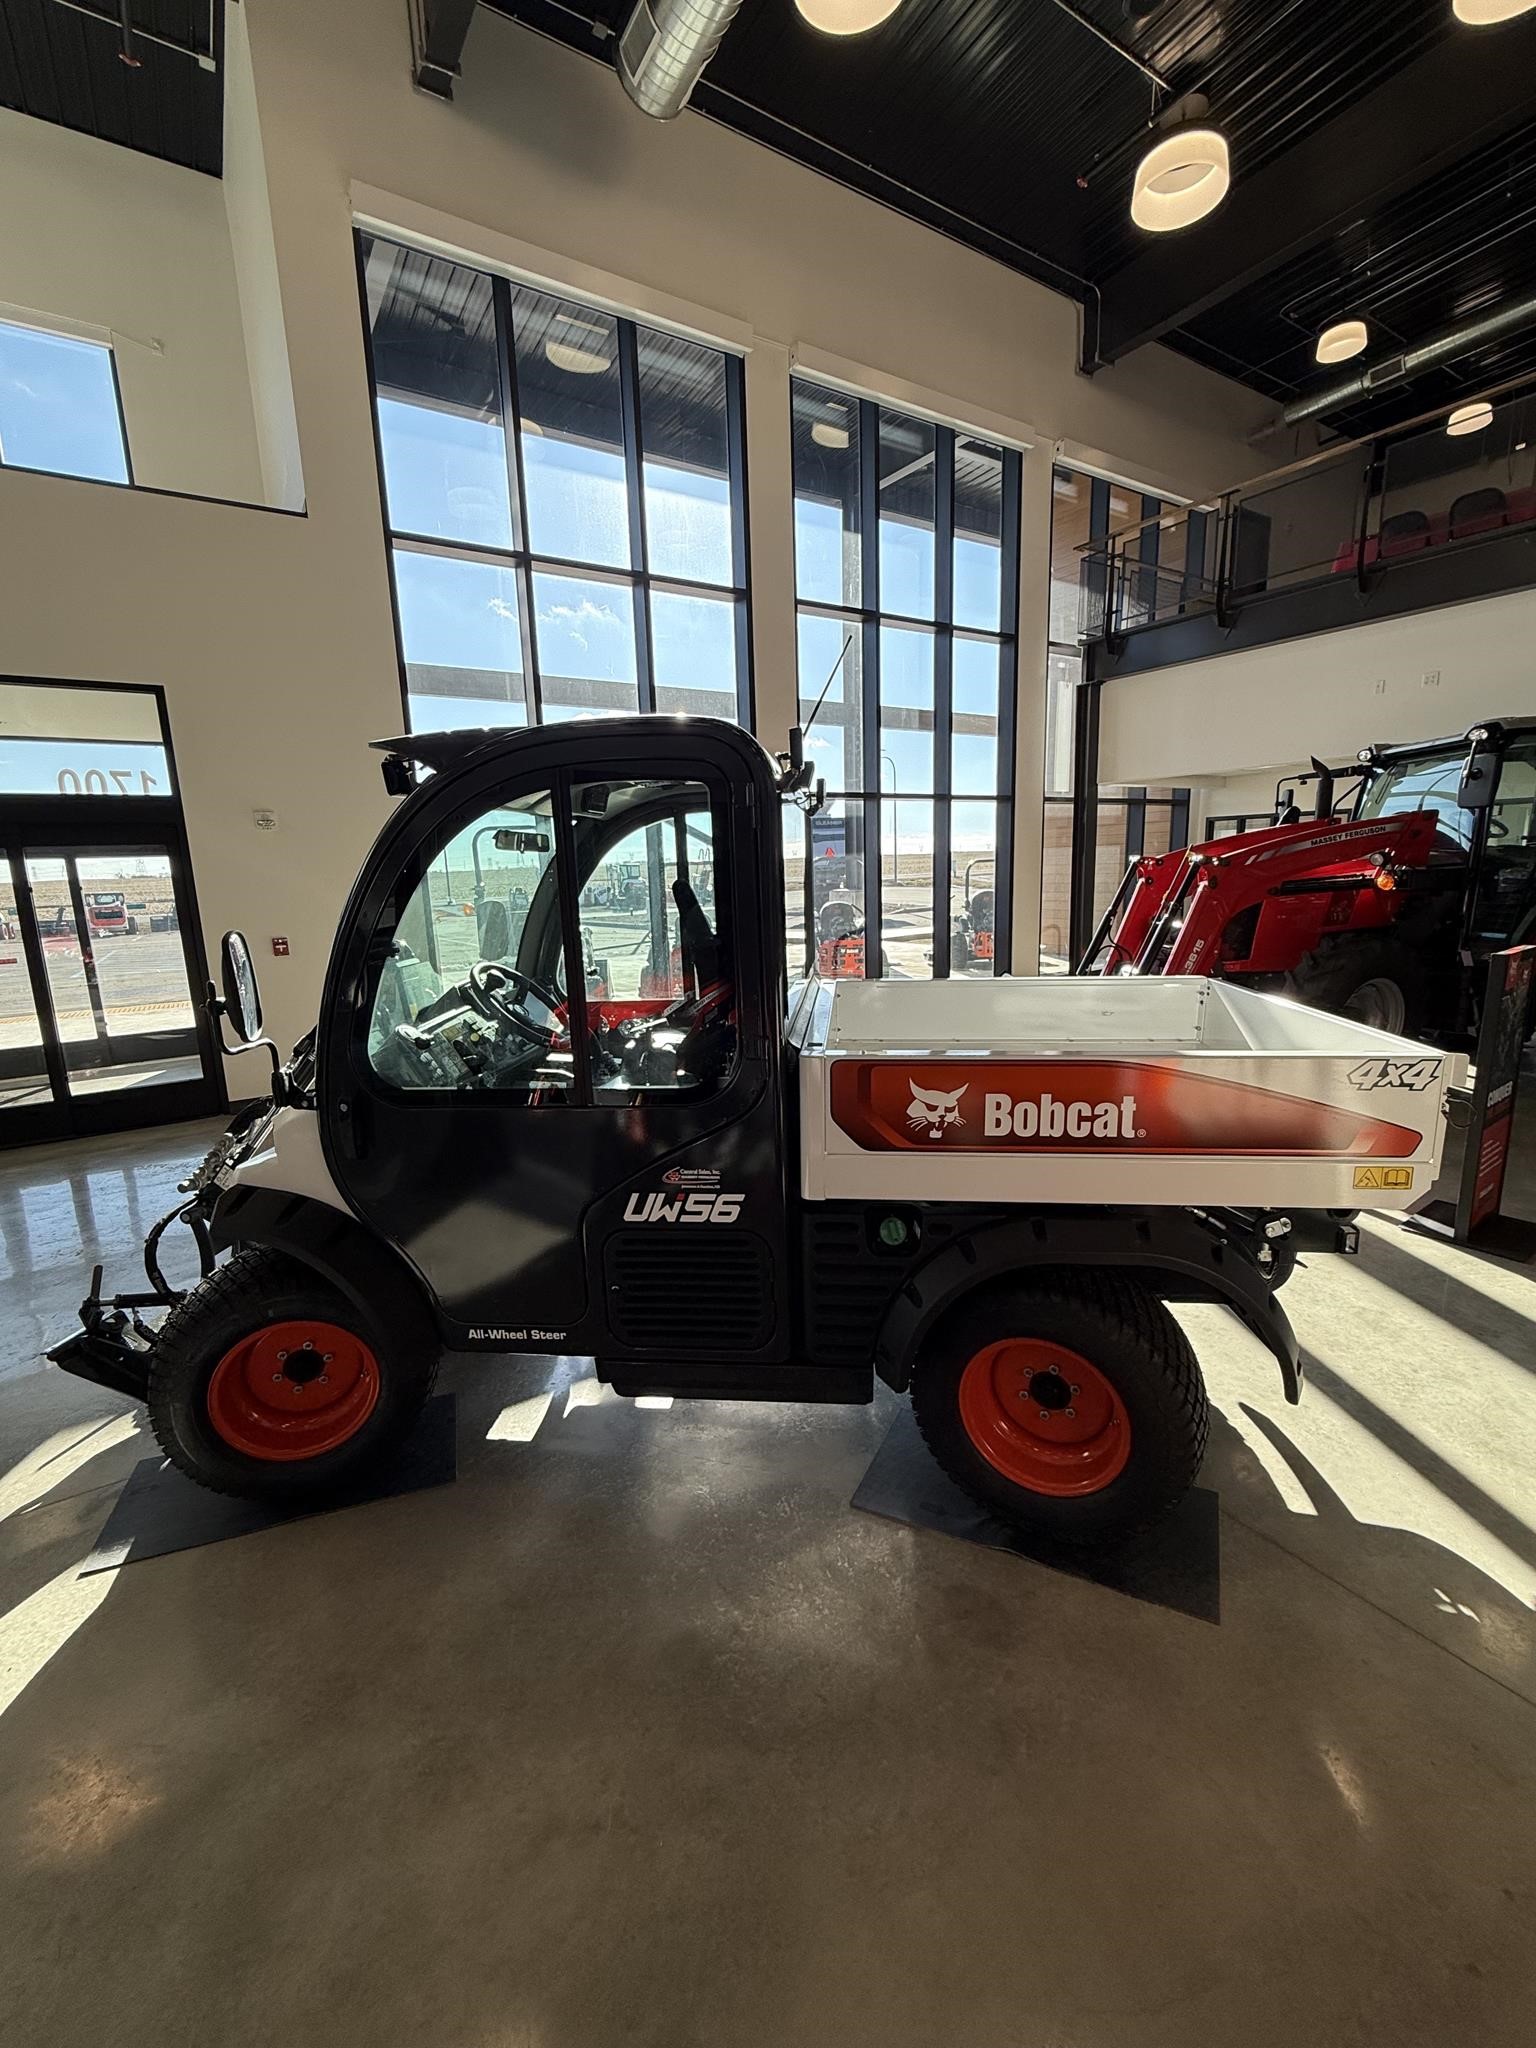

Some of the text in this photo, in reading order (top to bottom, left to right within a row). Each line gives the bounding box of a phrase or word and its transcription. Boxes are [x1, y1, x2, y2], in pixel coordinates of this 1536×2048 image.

[1310, 825, 1387, 847] MASSEY FERGUSON
[1347, 1059, 1442, 1091] 4x4
[984, 1093, 1137, 1138] Bobcat
[468, 1328, 567, 1340] All-Wheel Steer
